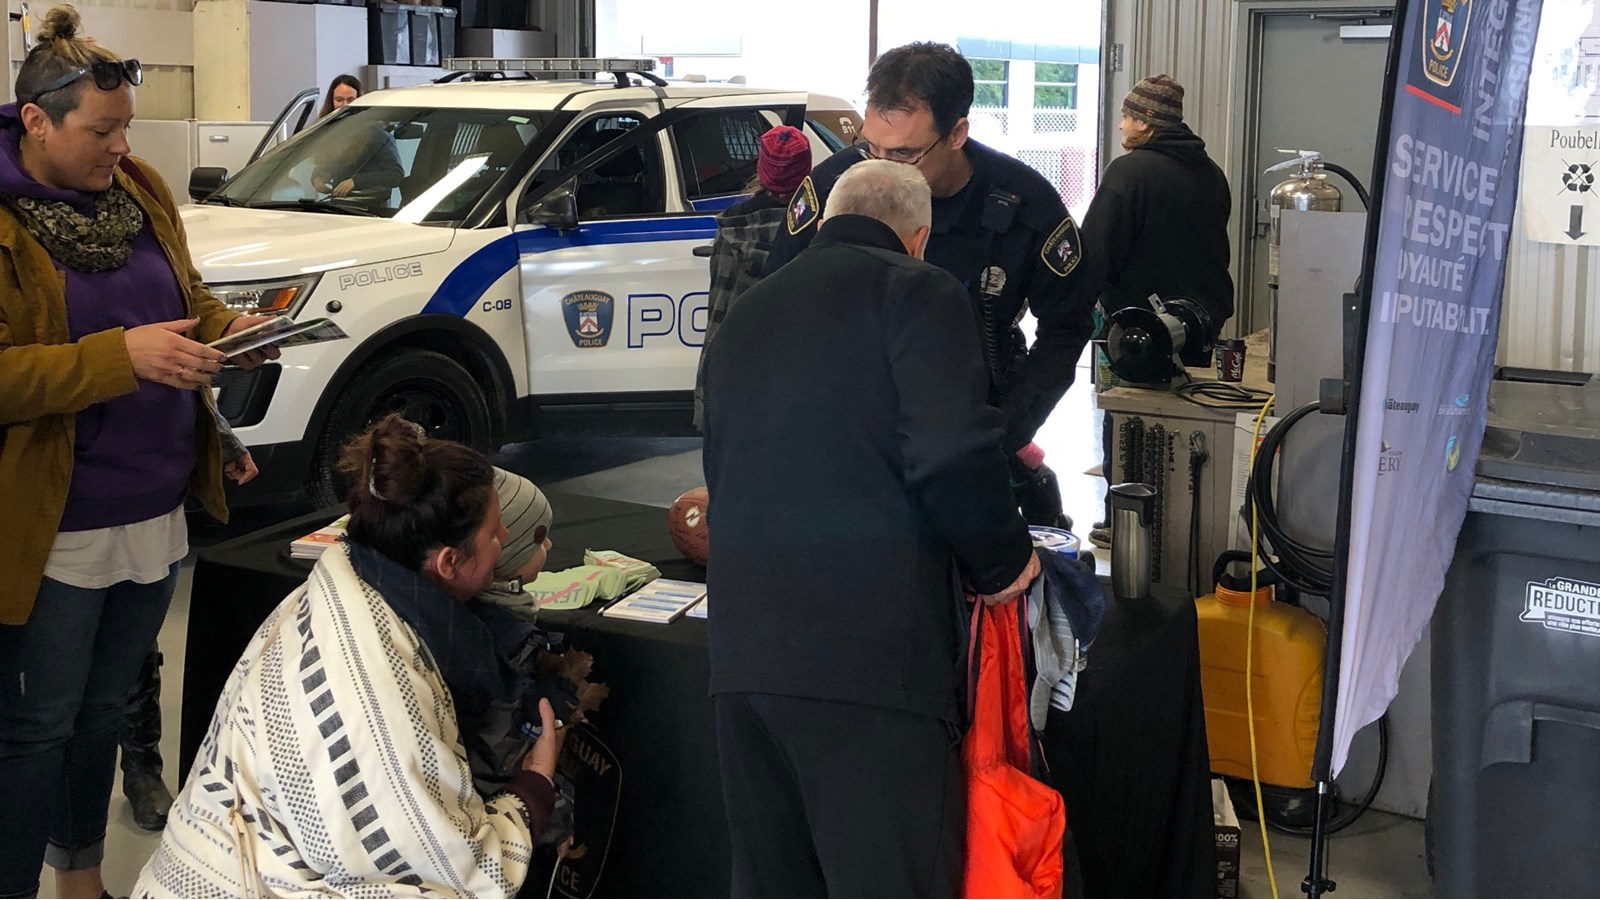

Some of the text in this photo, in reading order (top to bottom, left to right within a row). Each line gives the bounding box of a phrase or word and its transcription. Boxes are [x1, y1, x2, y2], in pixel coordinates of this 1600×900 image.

[1428, 59, 1449, 79] POLICE
[1392, 133, 1499, 207] SERVICE
[339, 261, 424, 291] POLICE
[482, 298, 512, 313] C-08
[564, 292, 611, 306] CHÂTEAUGUAY
[579, 338, 603, 347] POLICE
